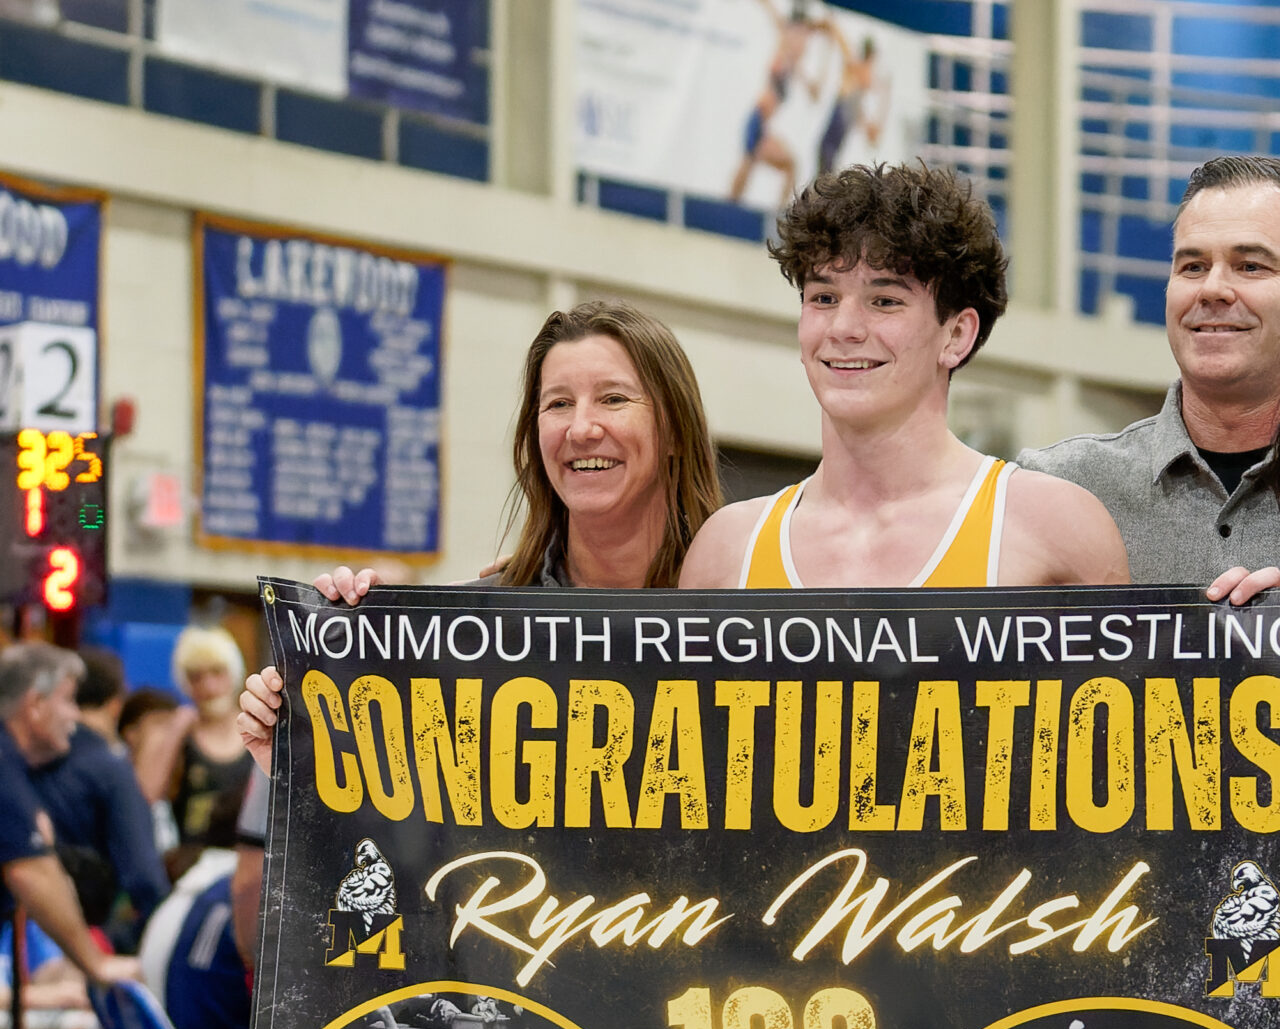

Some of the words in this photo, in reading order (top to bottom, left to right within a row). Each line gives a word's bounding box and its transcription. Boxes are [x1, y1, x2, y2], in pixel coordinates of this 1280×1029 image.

[37, 339, 79, 419] 2
[44, 547, 81, 611] 2
[287, 609, 612, 663] MONMOUTH
[635, 616, 939, 664] REGIONAL
[424, 850, 735, 988] Ryan
[761, 848, 1160, 966] Walsh
